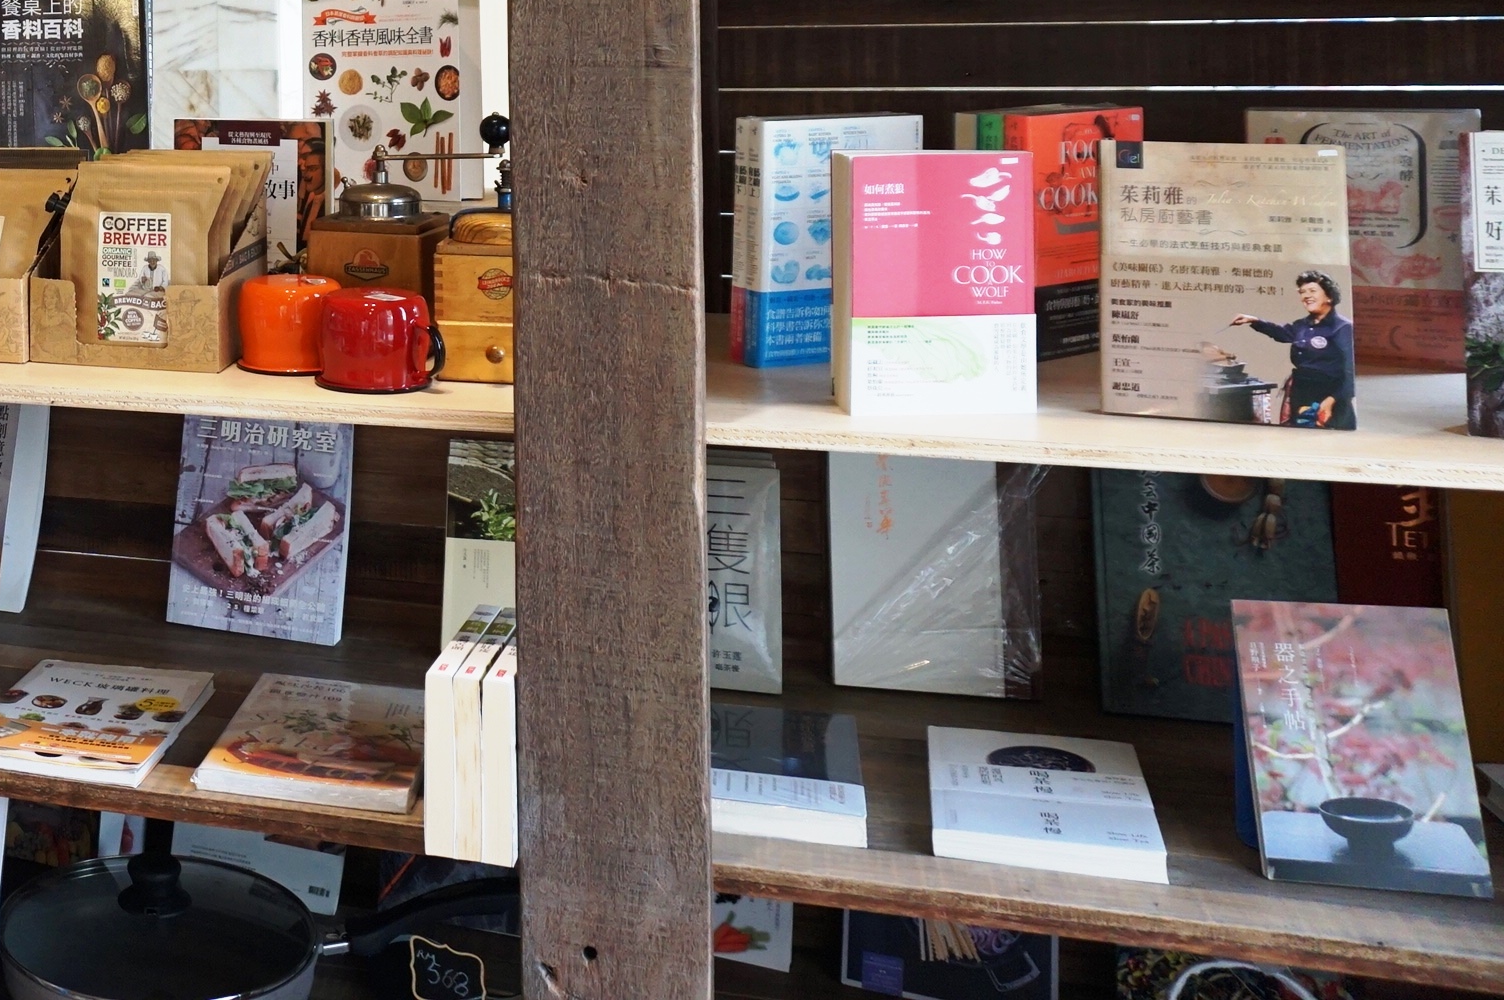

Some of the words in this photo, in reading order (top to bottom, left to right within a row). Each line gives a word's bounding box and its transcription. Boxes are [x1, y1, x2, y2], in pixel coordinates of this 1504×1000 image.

[1, 18, 84, 40] 香料百科
[312, 25, 433, 48] 香料香草風味全書
[1314, 134, 1410, 150] FERMENTATION
[1334, 128, 1352, 138] The
[1354, 130, 1376, 140] ART
[864, 183, 905, 195] 如何煮狼
[1039, 185, 1098, 211] COOK
[102, 216, 167, 232] COFFEE
[1120, 207, 1213, 226] 私房廚藝書
[103, 232, 167, 246] BREWER
[972, 249, 1007, 260] HOW
[347, 266, 388, 275] ZASSENHAUS
[953, 265, 1024, 285] COOK
[971, 287, 1009, 298] WOLF
[1113, 358, 1140, 367] 王宣一
[196, 417, 338, 454] 三明治研究室
[50, 676, 95, 688] WECK
[1274, 640, 1306, 731] 器之手帖
[139, 698, 154, 708] 5
[416, 948, 439, 965] RM
[427, 960, 471, 998] 568
